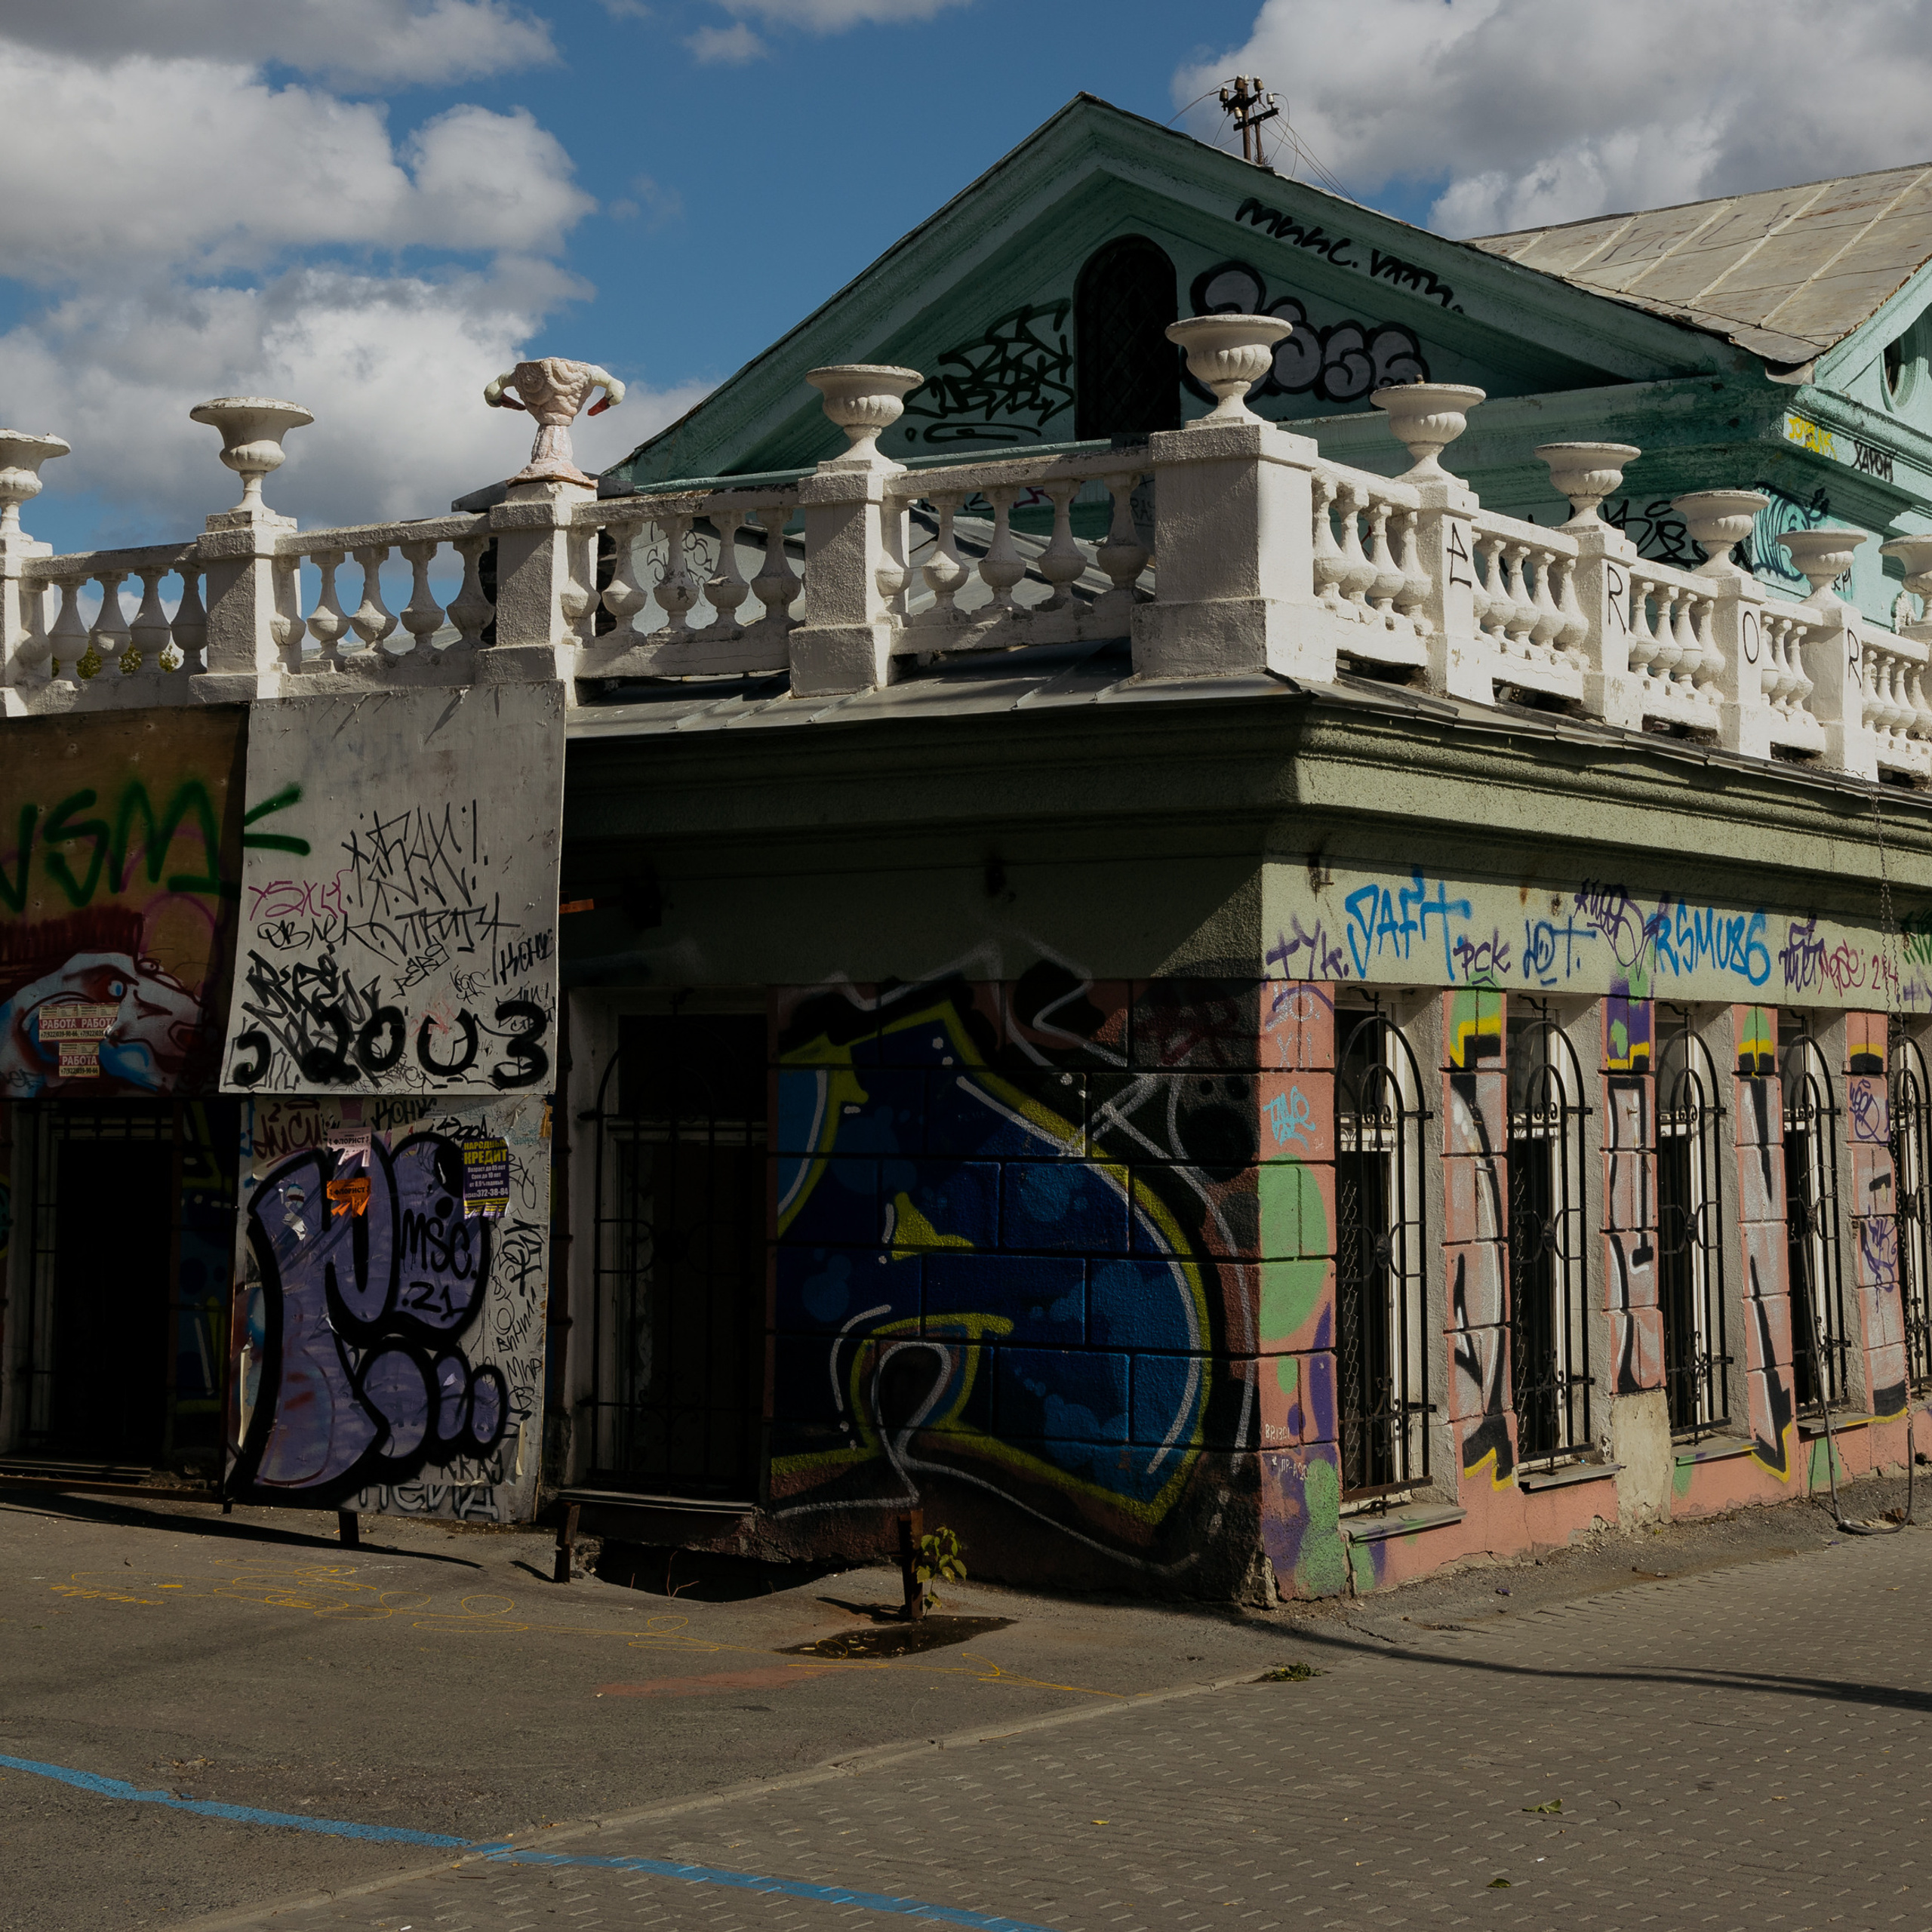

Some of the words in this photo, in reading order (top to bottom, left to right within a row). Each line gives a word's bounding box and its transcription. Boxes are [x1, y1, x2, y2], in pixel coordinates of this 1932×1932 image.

[42, 1020, 76, 1029] РАБОТА
[62, 1056, 97, 1066] РАБОТА
[334, 1137, 365, 1145] ФЛОРИСТ
[464, 1139, 507, 1150] НАРОДНЫЙ
[464, 1149, 508, 1165] КРЕДИТ
[334, 1186, 366, 1195] ФЛОРИСТ
